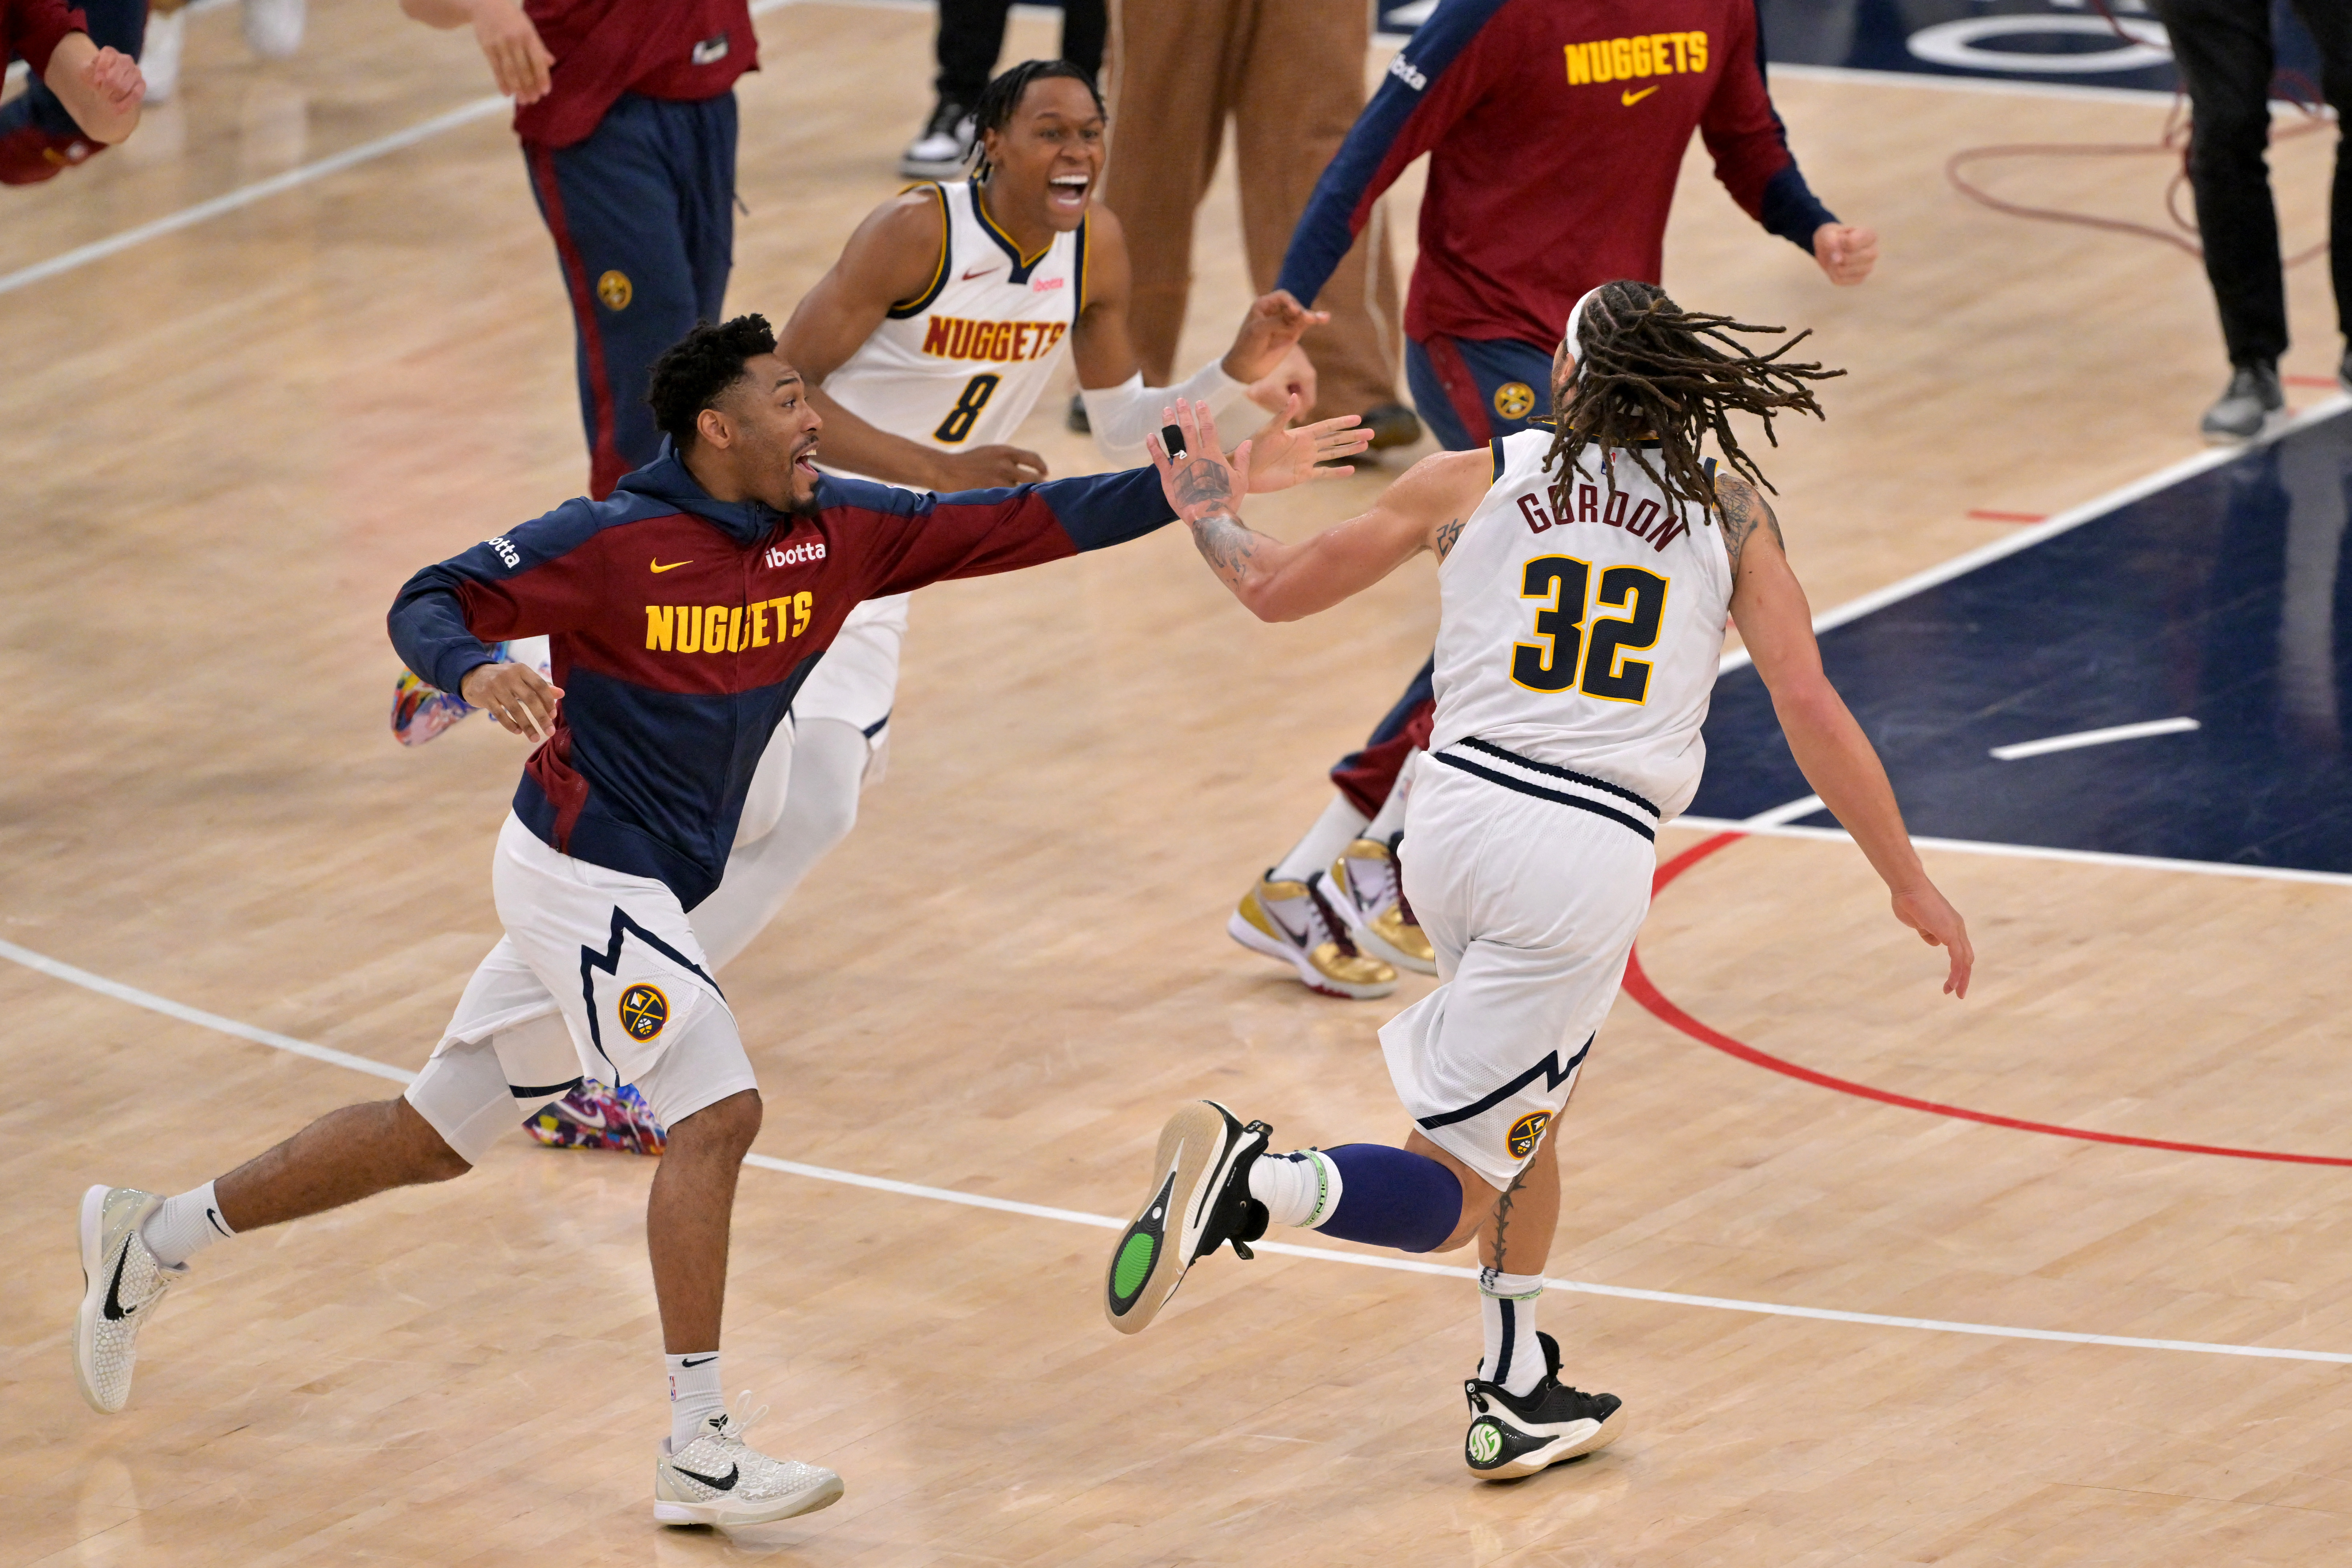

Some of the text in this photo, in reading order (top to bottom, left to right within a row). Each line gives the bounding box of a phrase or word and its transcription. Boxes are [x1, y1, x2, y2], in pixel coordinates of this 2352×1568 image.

[1564, 31, 1708, 85] NUGGETS
[922, 314, 1068, 363] NUGGETS
[932, 372, 1003, 445] 8
[1517, 483, 1684, 552] GORDON
[485, 537, 520, 568] otta
[765, 543, 826, 568] ibotta
[646, 591, 813, 654] NUGGETS
[1509, 554, 1670, 706] 32
